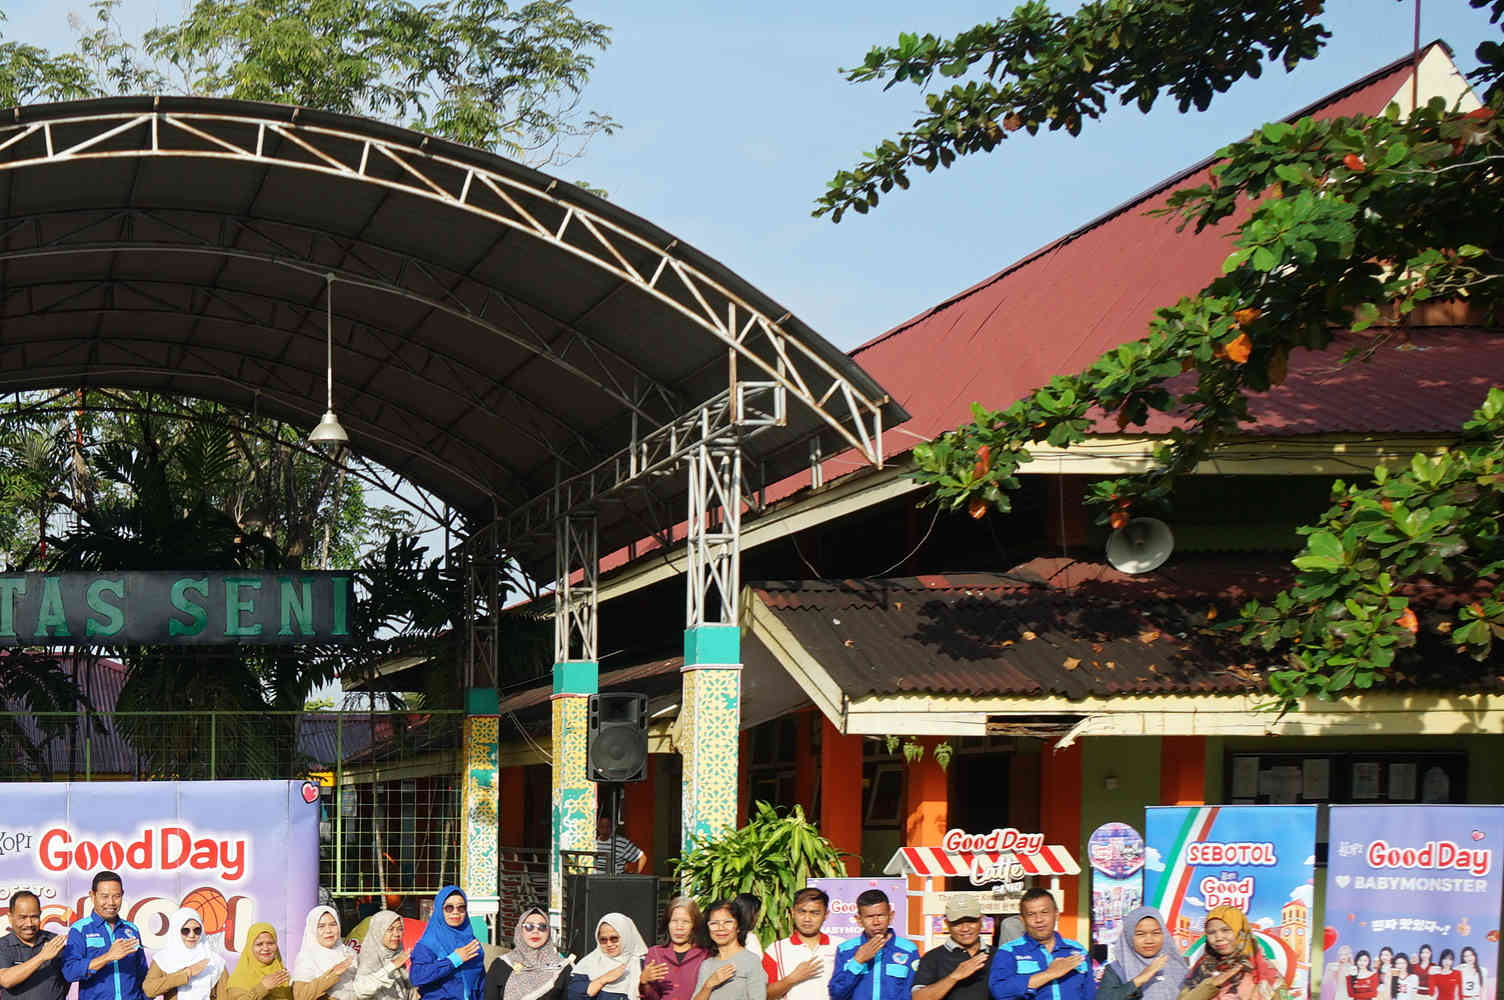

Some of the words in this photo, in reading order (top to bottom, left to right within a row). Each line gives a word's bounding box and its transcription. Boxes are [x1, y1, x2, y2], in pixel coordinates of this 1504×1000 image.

[168, 576, 352, 638] SENI
[947, 831, 999, 851] Good
[1002, 831, 1042, 854] Day
[39, 827, 153, 872] Good
[161, 827, 245, 881] Day
[1189, 845, 1273, 862] SEBOTOL
[1368, 842, 1434, 867] Good
[1438, 842, 1489, 875] Day
[1203, 879, 1250, 894] Good
[1354, 877, 1488, 893] BABYMONSTER
[831, 900, 857, 913] Goo
[1208, 895, 1246, 909] Day
